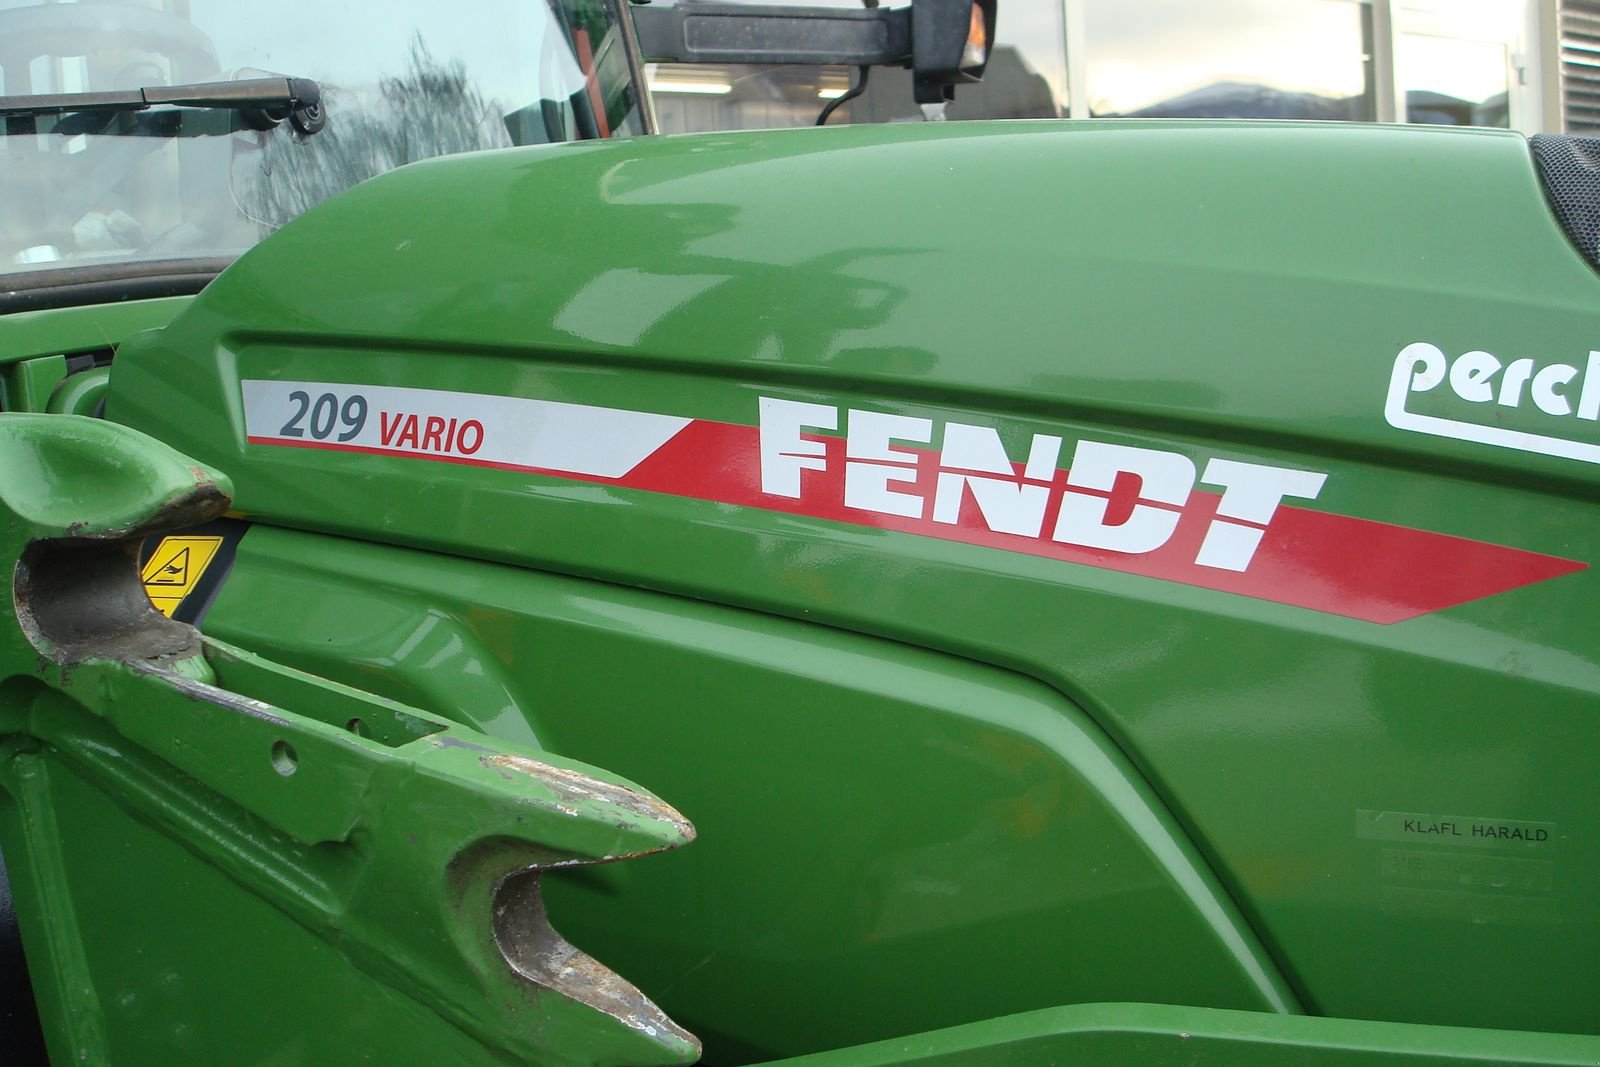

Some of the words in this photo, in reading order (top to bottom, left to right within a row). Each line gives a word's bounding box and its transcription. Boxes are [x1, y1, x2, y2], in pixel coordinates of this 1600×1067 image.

[280, 390, 368, 442] 209
[380, 411, 485, 455] VARIO
[758, 396, 1328, 572] FENDT
[1403, 819, 1462, 836] KLAFL
[1472, 824, 1548, 841] HARALD
